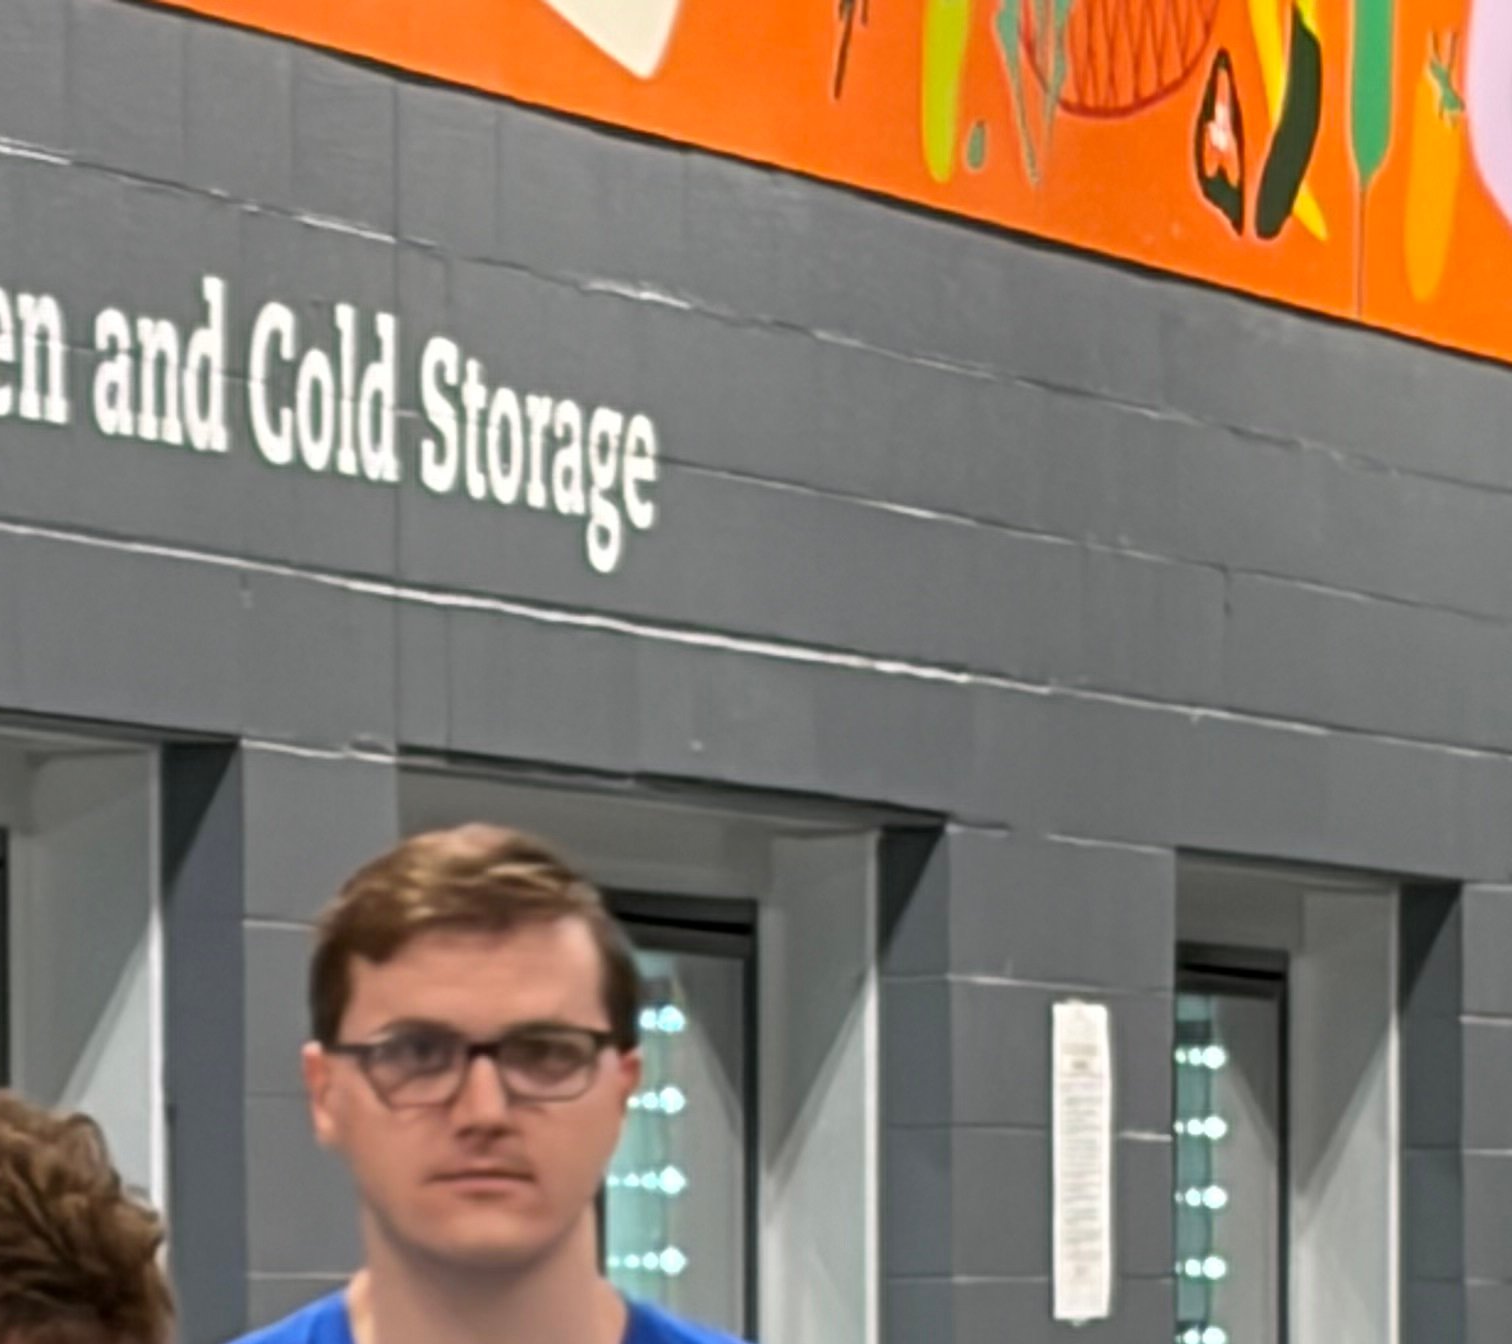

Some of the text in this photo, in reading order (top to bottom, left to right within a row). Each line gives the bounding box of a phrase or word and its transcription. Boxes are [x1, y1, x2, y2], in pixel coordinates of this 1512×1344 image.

[94, 276, 227, 452] and
[248, 302, 398, 482] Cold
[421, 337, 656, 573] Storage
